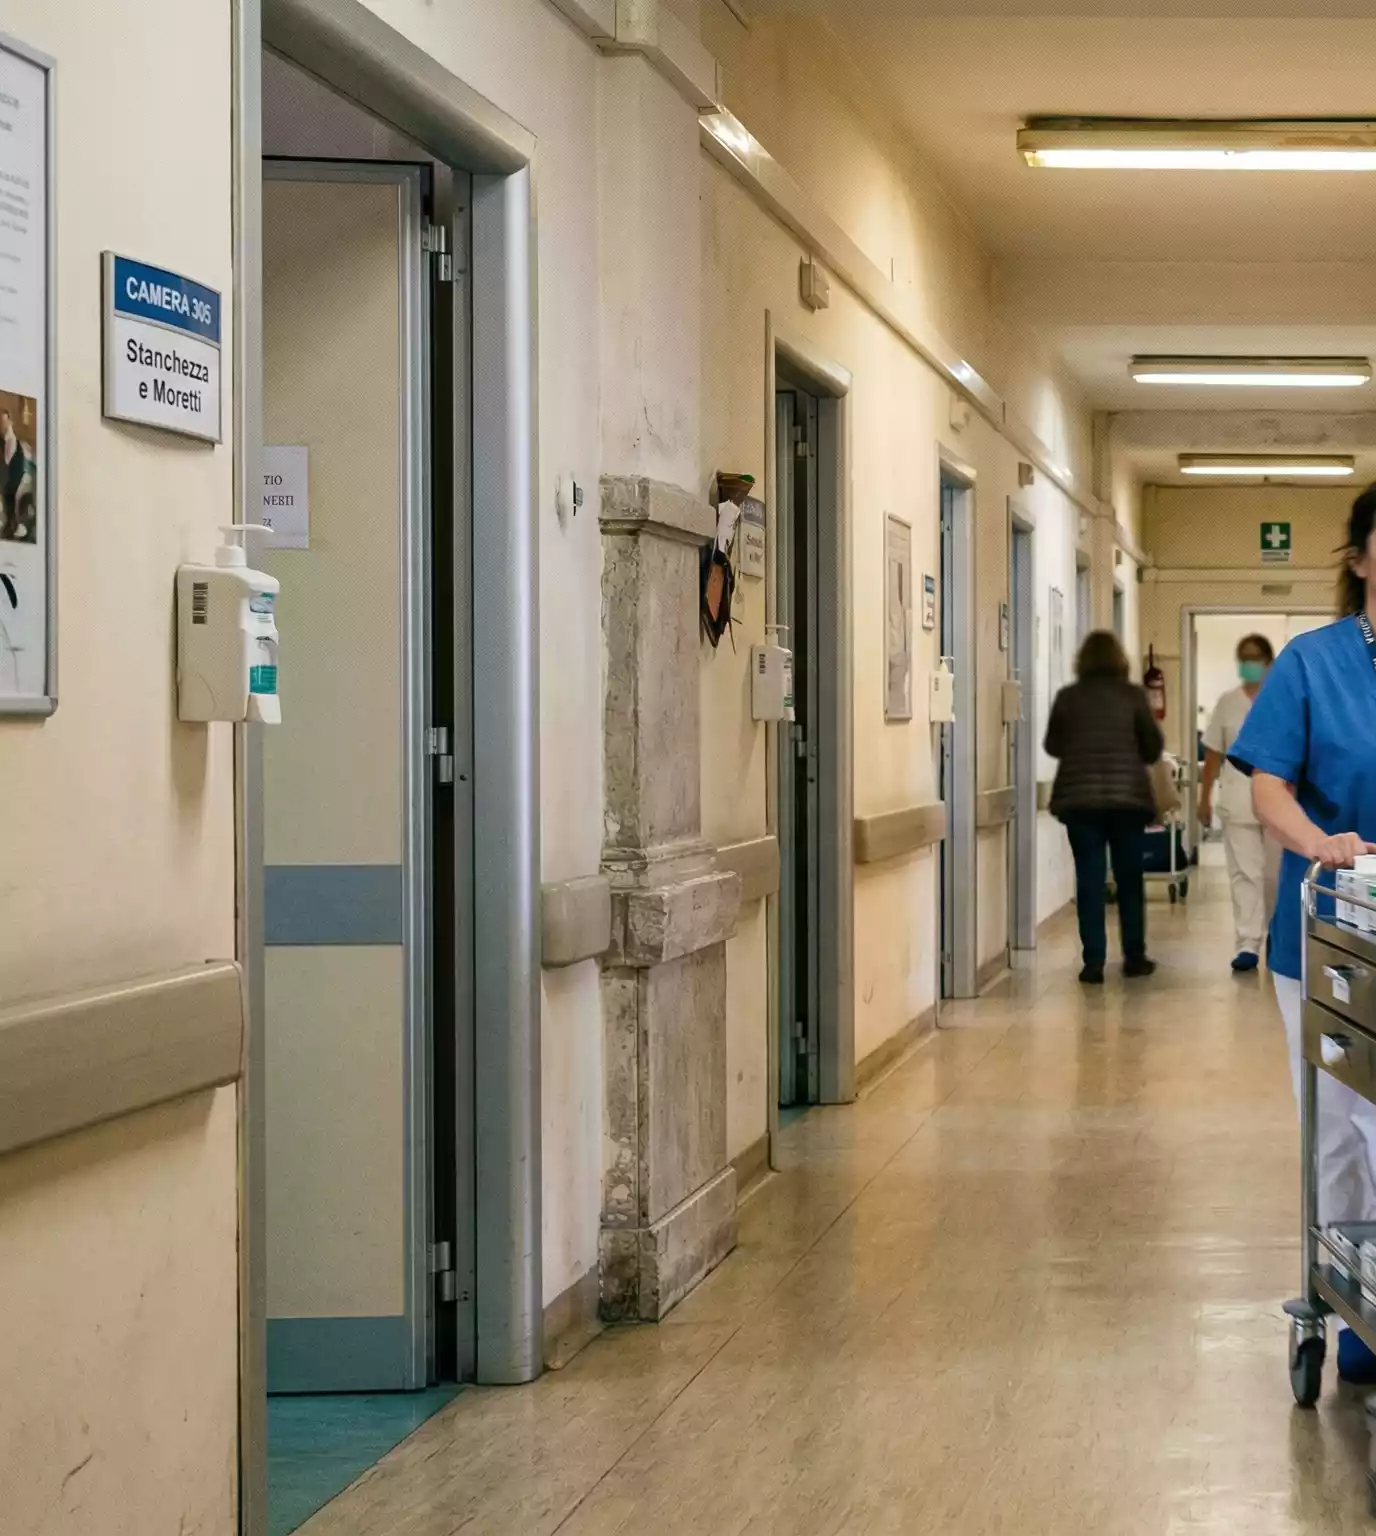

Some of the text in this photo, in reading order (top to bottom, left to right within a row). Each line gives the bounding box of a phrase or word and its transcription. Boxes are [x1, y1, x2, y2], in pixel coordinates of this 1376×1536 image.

[126, 277, 212, 325] CAMERA 305
[126, 338, 209, 383] Stanchezza
[139, 379, 202, 413] e Moretti
